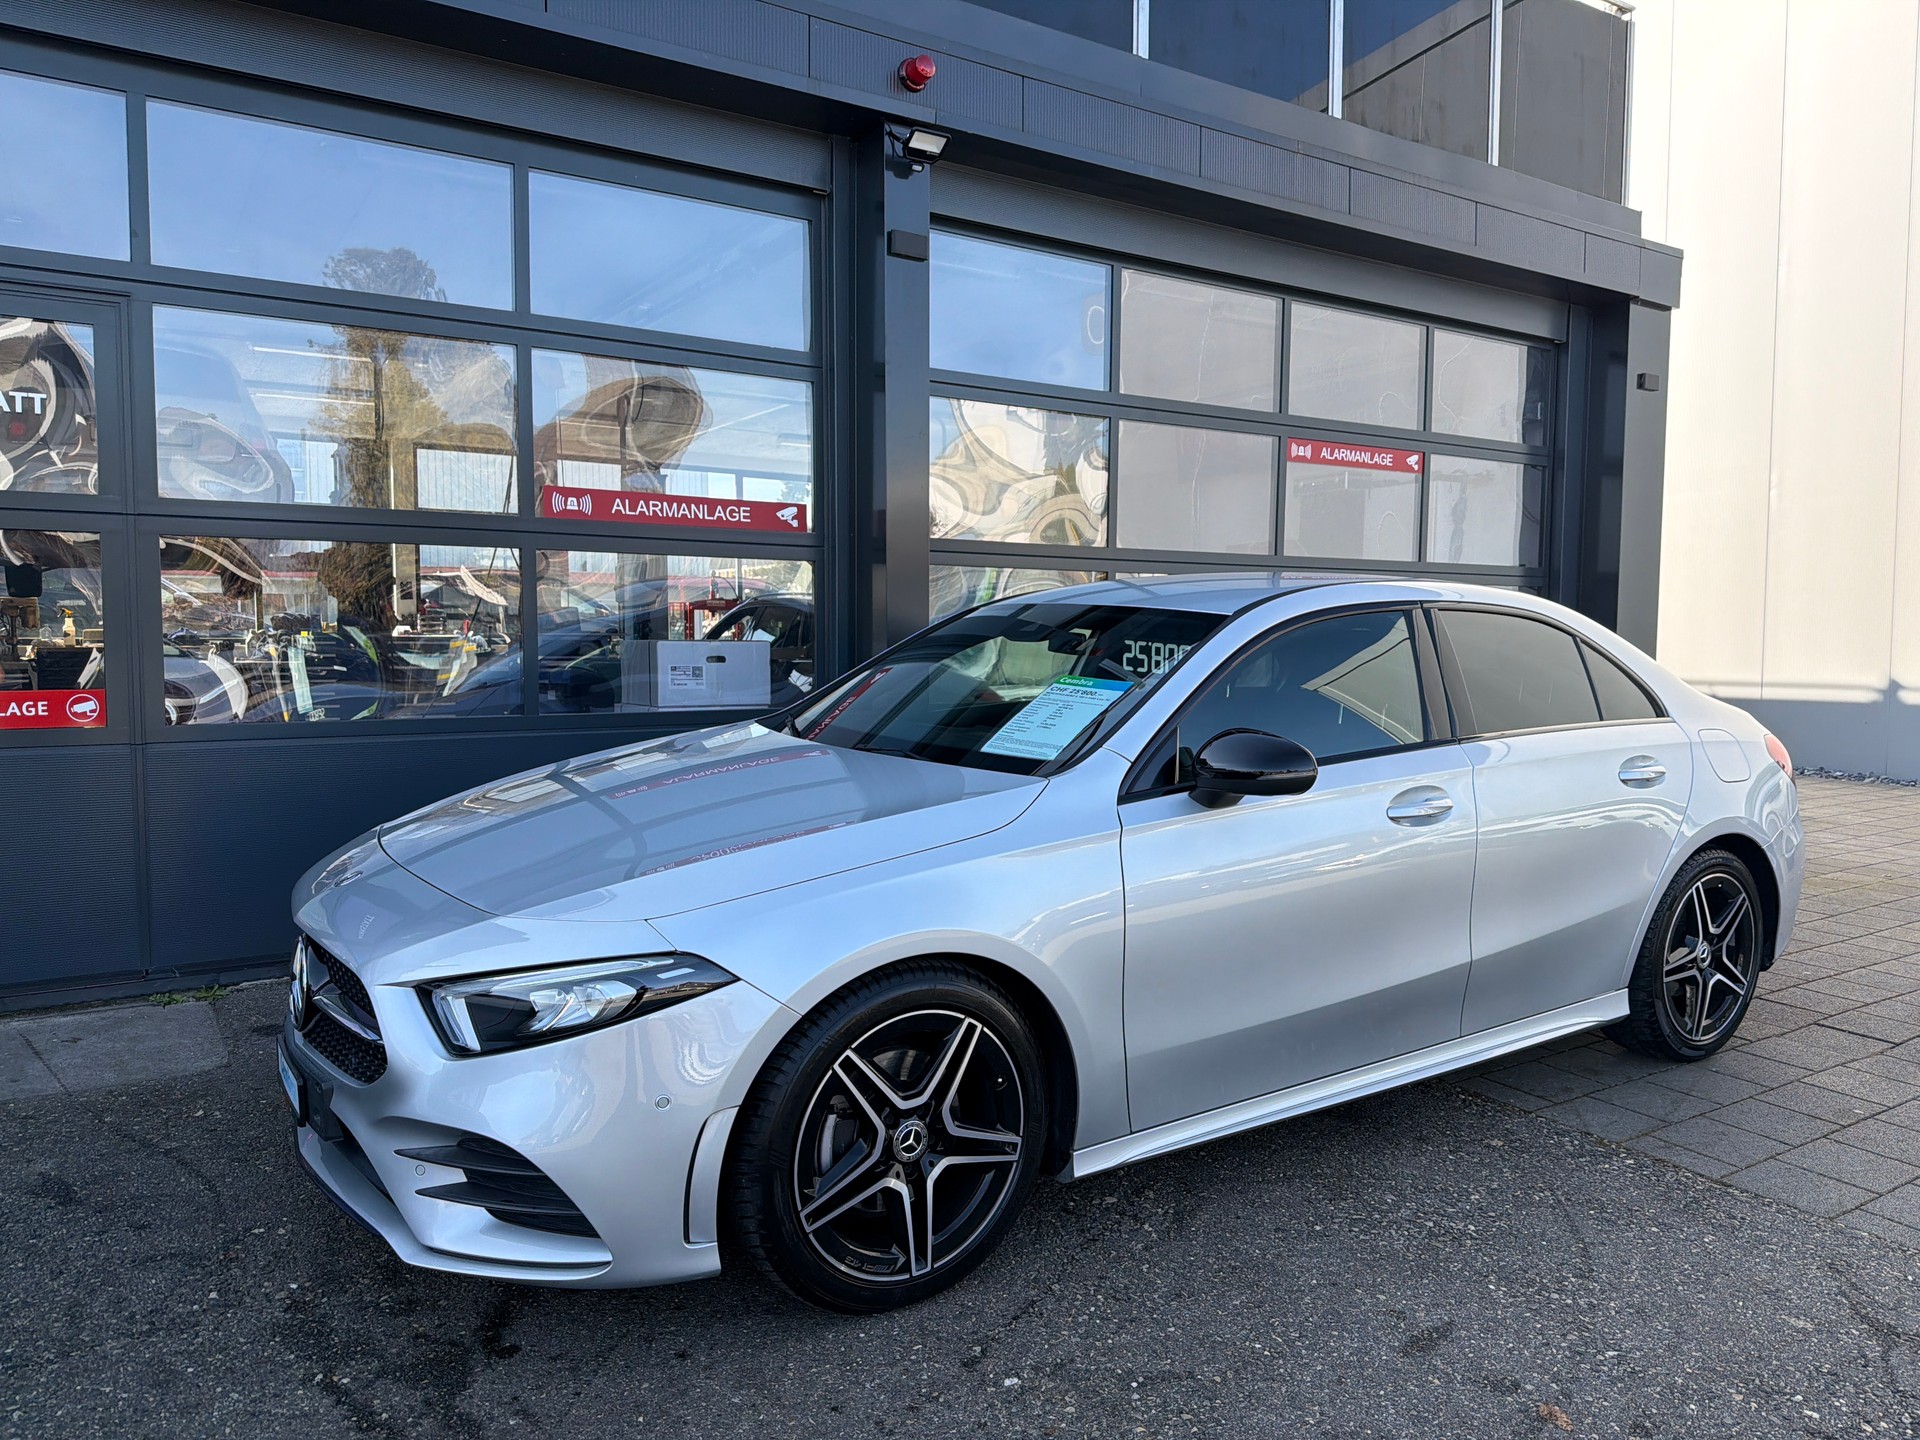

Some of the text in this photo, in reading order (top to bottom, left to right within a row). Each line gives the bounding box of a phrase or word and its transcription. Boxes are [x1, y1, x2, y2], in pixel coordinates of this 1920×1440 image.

[1320, 446, 1393, 466] ALARMANLAGE
[611, 498, 751, 522] ALARMANLAGE
[1059, 676, 1094, 686] Cembra
[1050, 686, 1068, 694] CHF
